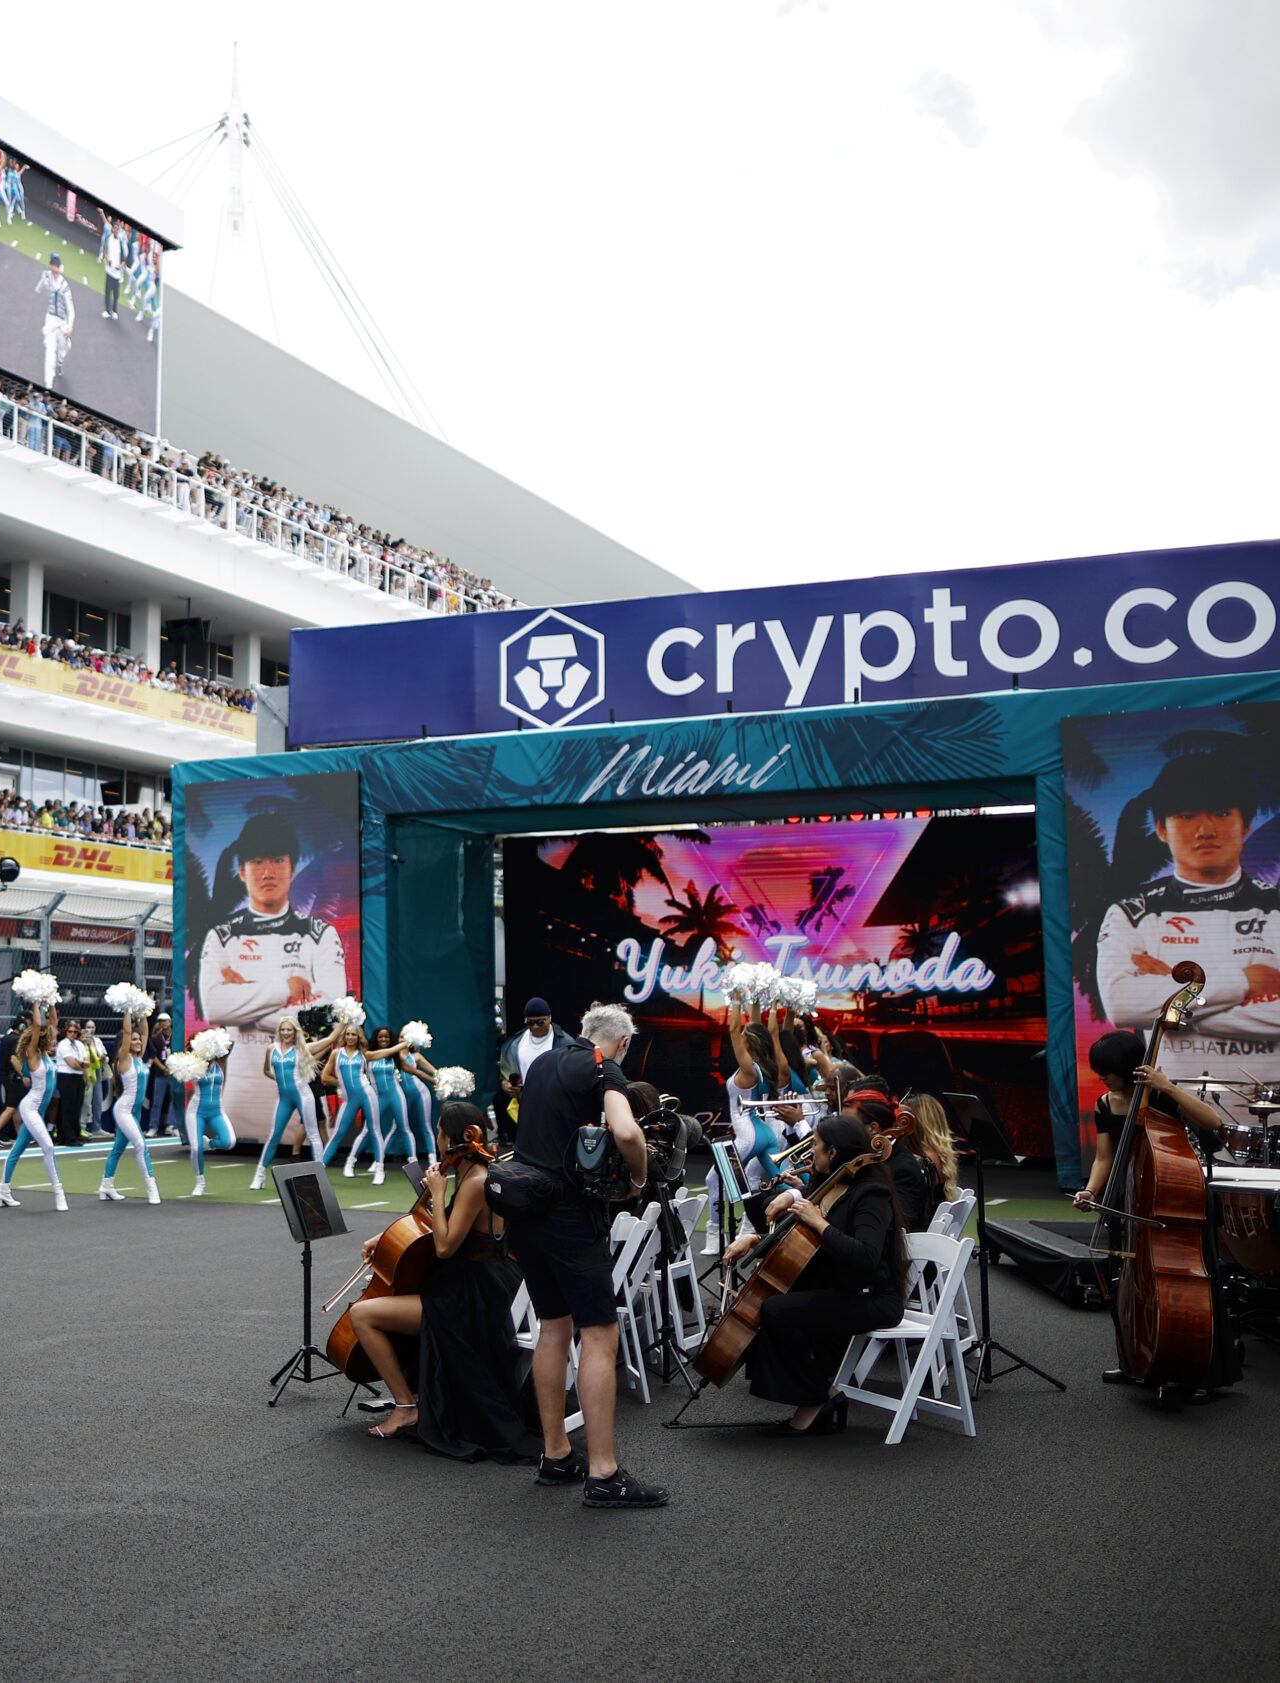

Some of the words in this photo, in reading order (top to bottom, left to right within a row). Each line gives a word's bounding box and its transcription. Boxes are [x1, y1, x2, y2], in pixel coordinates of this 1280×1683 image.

[76, 673, 137, 708] DHL
[181, 701, 233, 732] DHL
[579, 743, 791, 804] Miami
[47, 843, 113, 874] DHL
[1161, 935, 1200, 945] ORLEN
